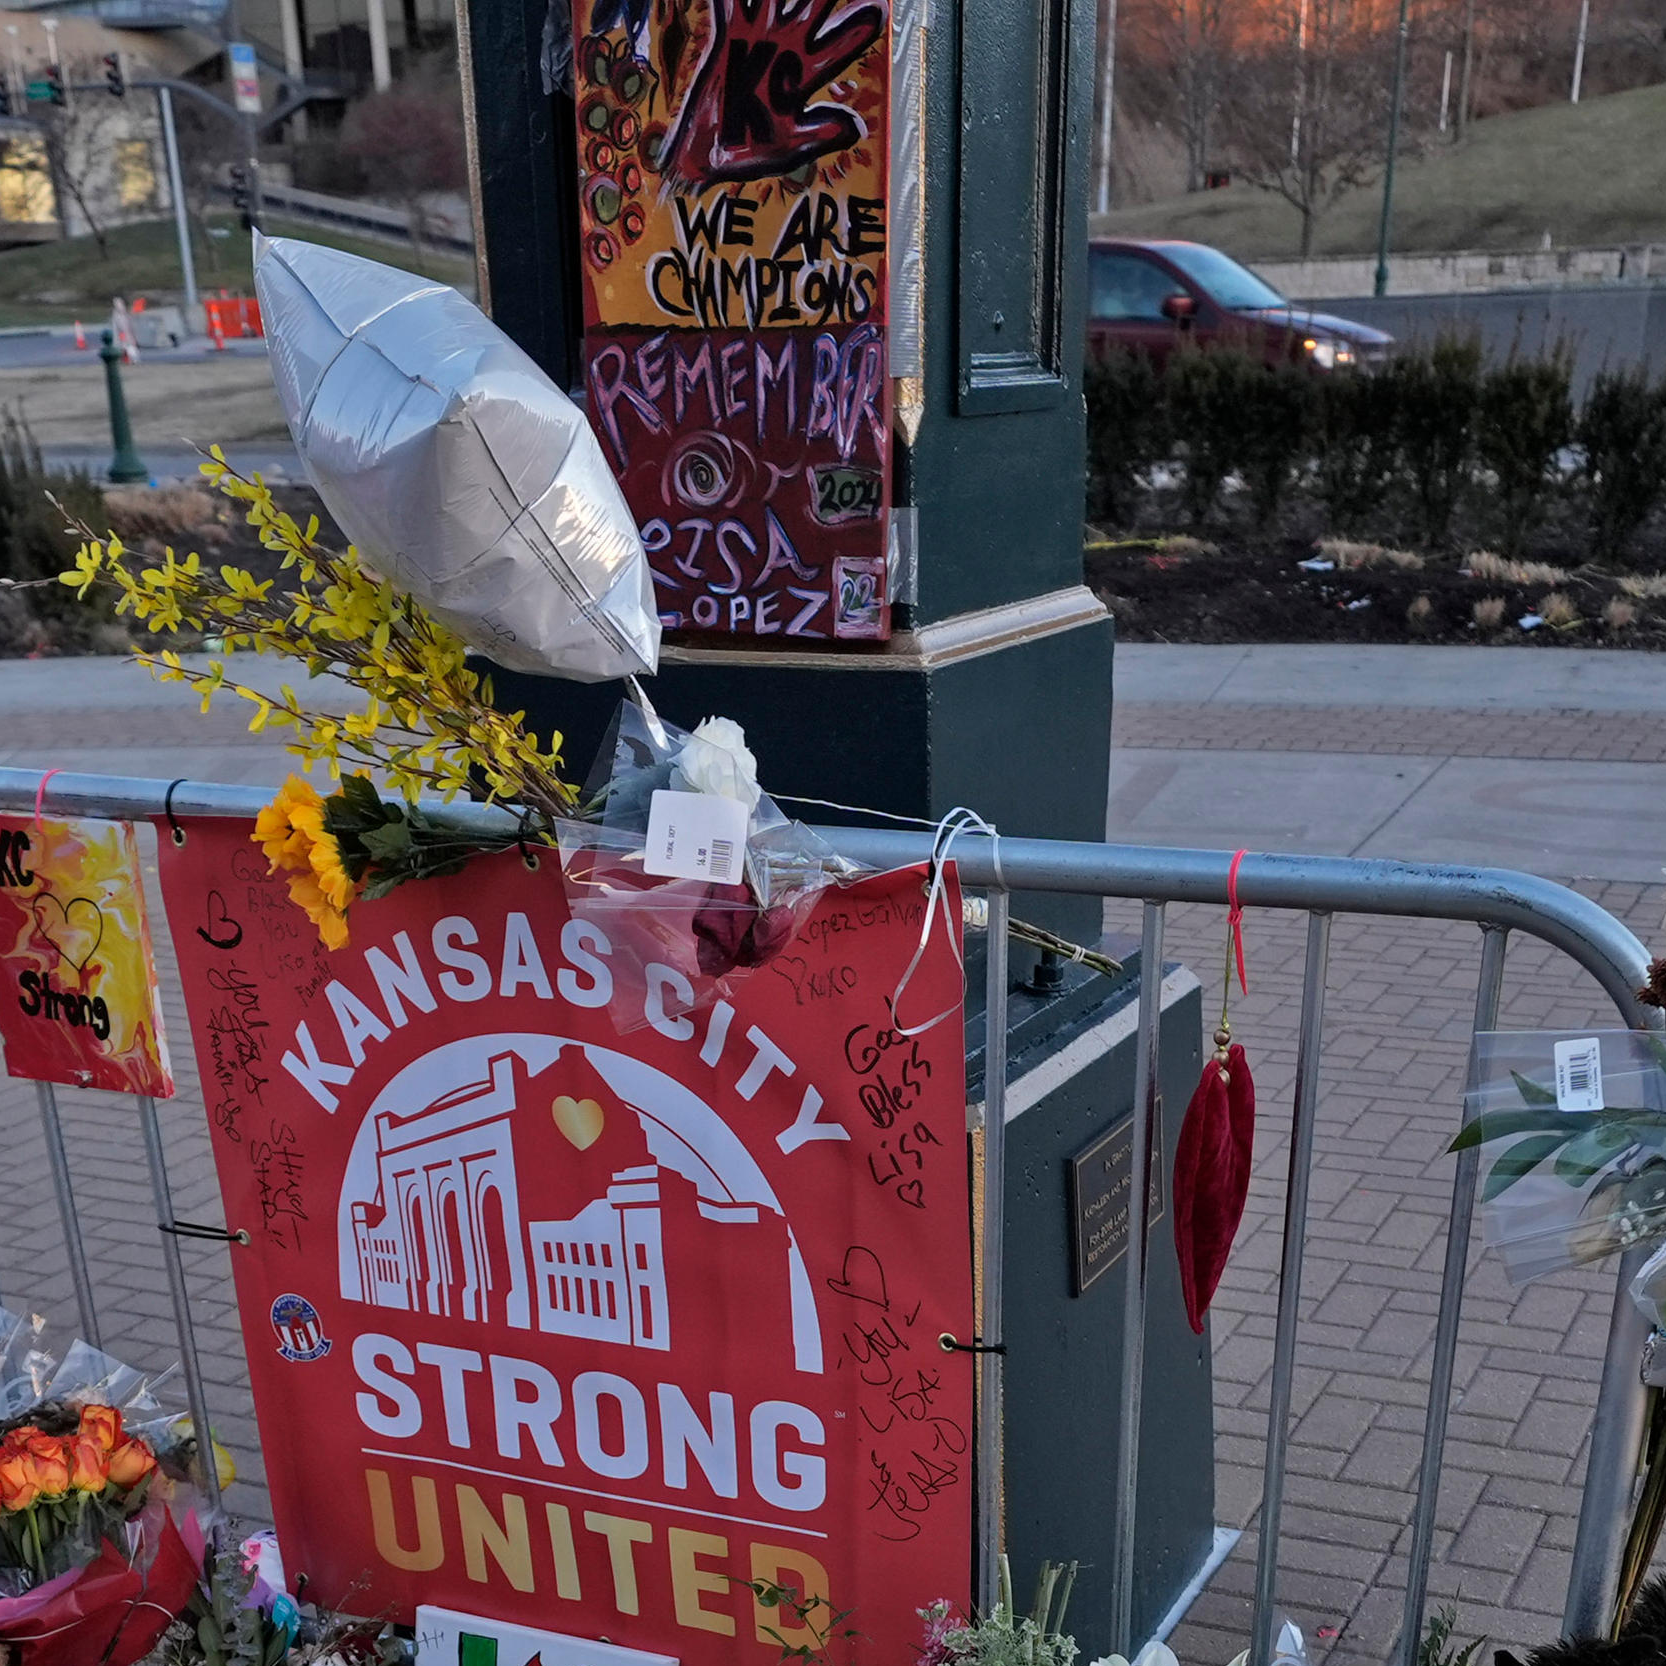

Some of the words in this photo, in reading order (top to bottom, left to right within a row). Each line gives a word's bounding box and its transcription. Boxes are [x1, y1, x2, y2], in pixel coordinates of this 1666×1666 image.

[674, 199, 755, 256] WE
[771, 198, 886, 262] ARE
[647, 248, 878, 331] CHAMPIONS
[590, 323, 887, 474] REMEMBER
[19, 970, 111, 1041] Strong
[280, 912, 613, 1114] KANSAS
[644, 970, 852, 1155] CITY
[844, 995, 911, 1075] God
[858, 1041, 932, 1129] Bless
[349, 1333, 828, 1513] STRONG
[364, 1469, 831, 1653] UNITED
